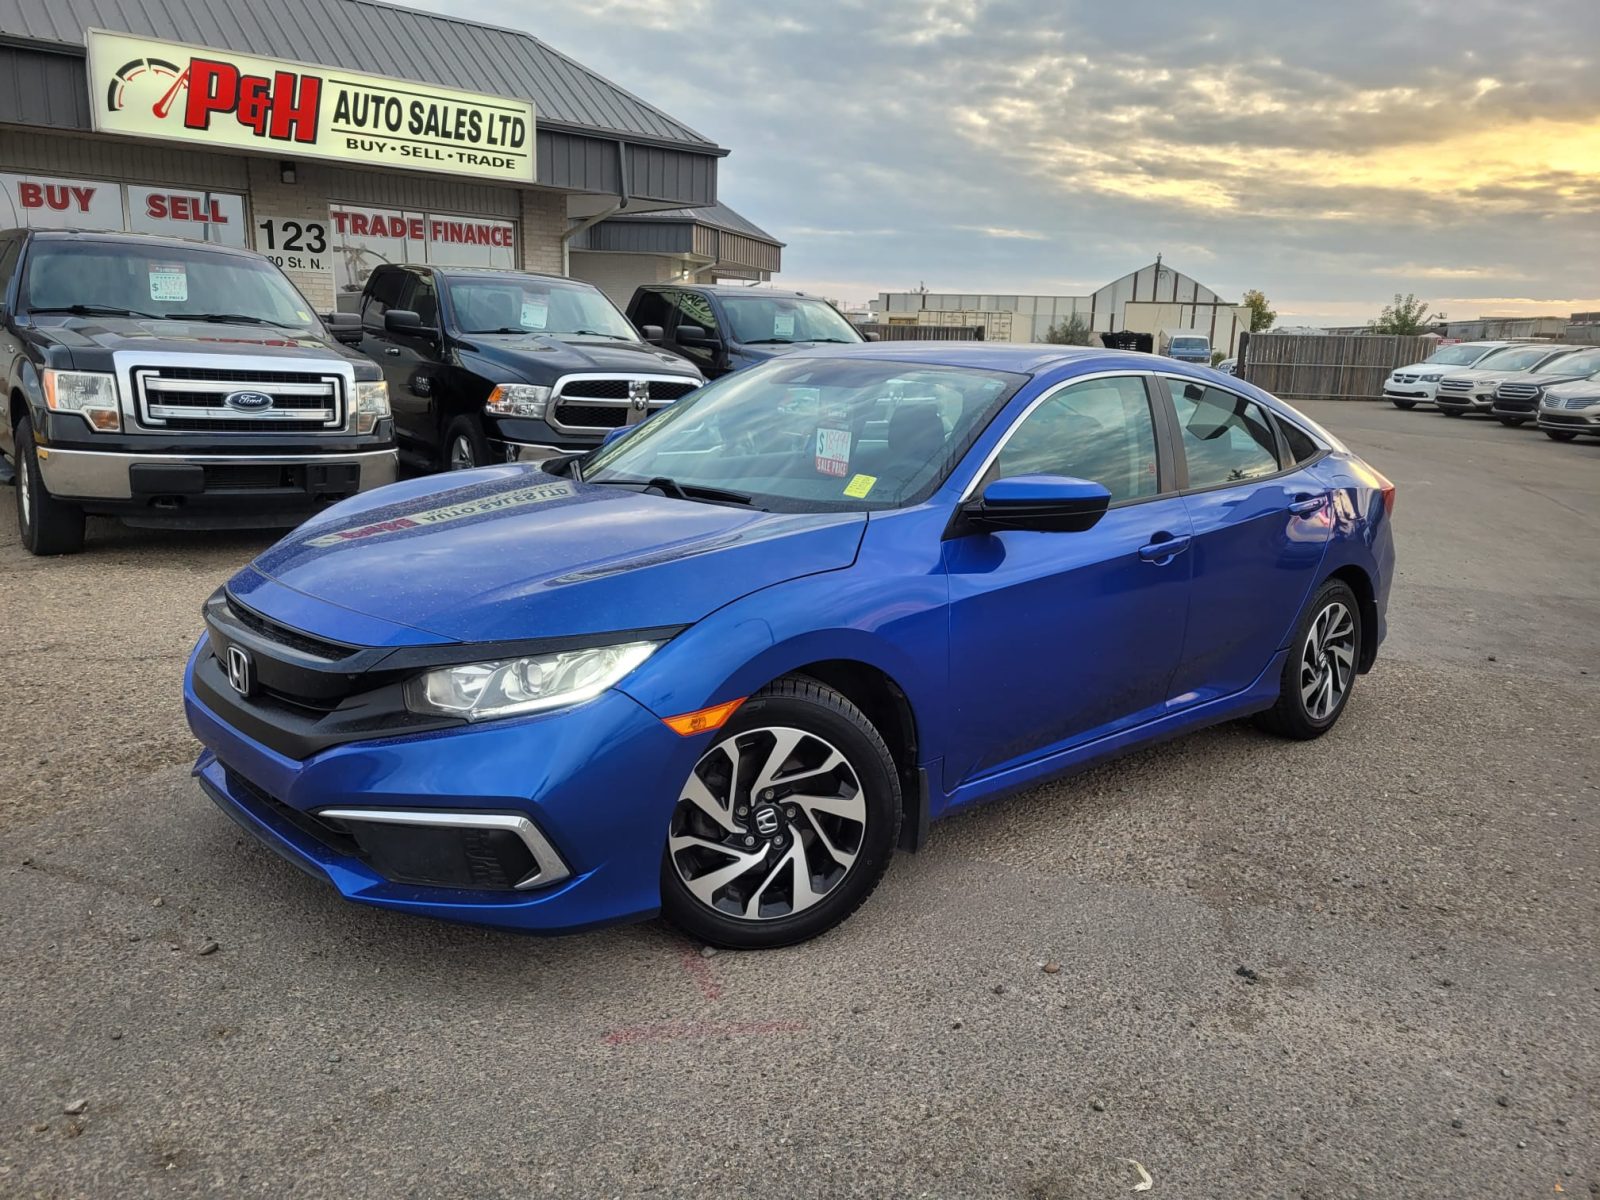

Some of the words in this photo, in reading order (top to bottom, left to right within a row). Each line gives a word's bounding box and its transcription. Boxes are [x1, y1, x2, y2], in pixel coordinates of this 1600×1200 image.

[184, 57, 323, 144] P&H
[333, 90, 402, 132] AUTO
[408, 100, 483, 143] SALES
[487, 113, 525, 148] LTD
[346, 138, 387, 153] BUY
[400, 145, 445, 161] SELL
[456, 152, 516, 169] TRADE
[19, 182, 96, 212] BUY
[147, 194, 229, 223] SELL
[260, 220, 326, 253] 123
[331, 211, 424, 240] TRADE
[431, 220, 513, 248] FINANCE
[288, 257, 305, 268] St.
[311, 258, 324, 269] N.
[817, 457, 831, 472] SALE
